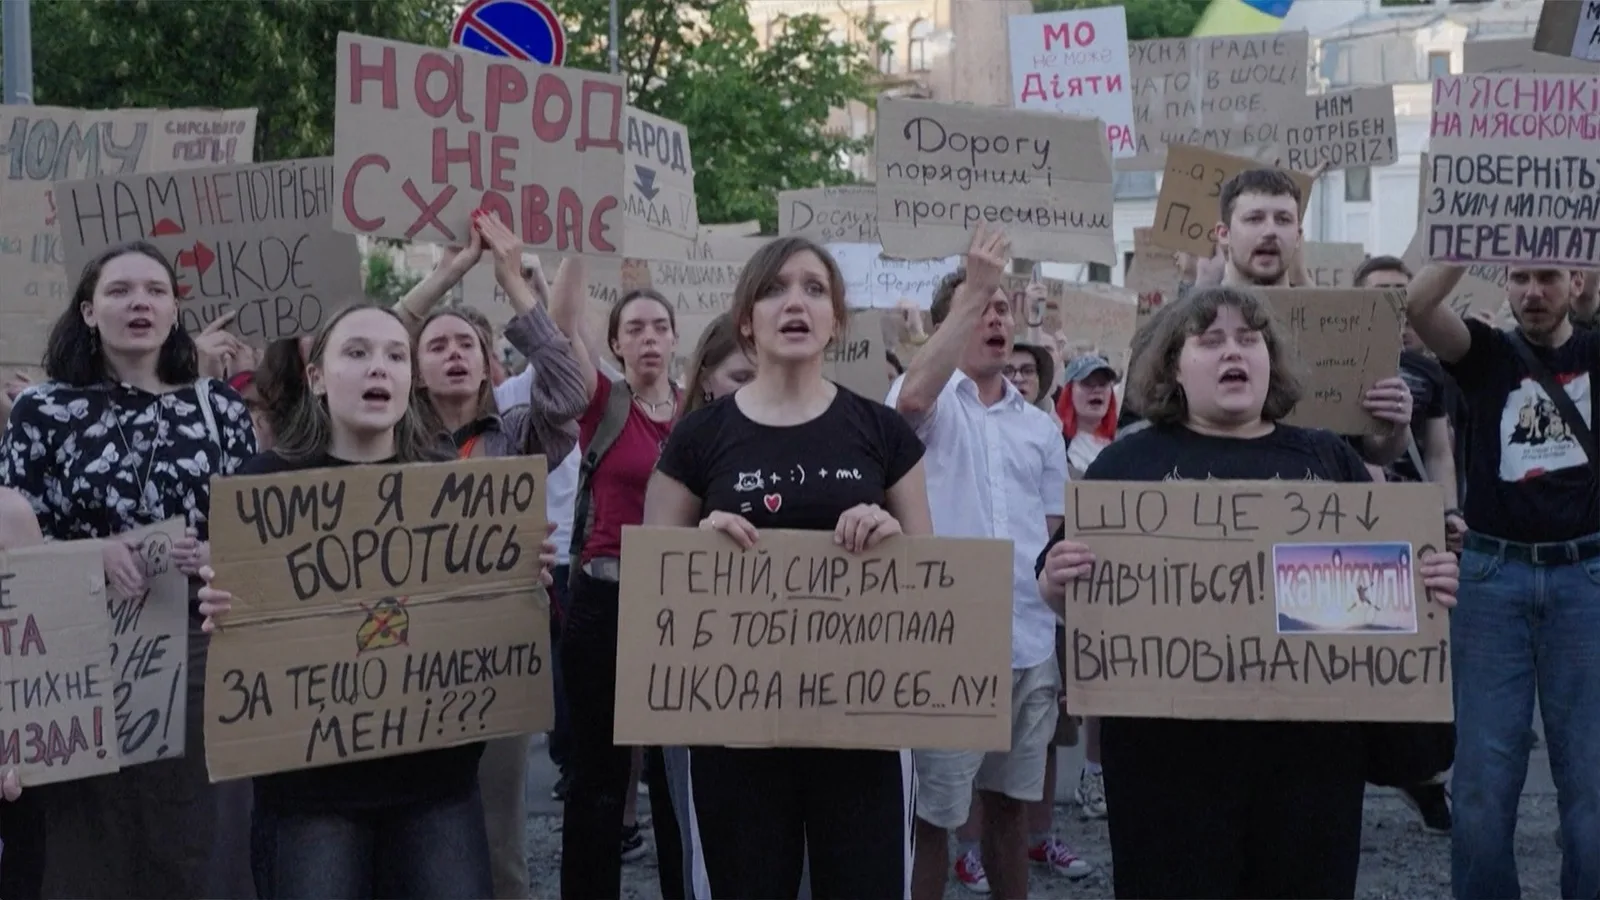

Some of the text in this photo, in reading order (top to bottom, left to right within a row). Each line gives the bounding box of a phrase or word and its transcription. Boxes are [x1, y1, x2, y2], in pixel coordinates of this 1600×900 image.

[1043, 20, 1096, 50] МО
[1286, 118, 1385, 145] ПОТРІБЕН
[1314, 94, 1353, 119] НАМ
[1430, 112, 1462, 138] НА
[431, 127, 520, 192] НЕ
[903, 116, 1050, 170] Дорогу
[886, 161, 1030, 191] порядним
[71, 176, 186, 246] НАМ
[894, 198, 1110, 230] прогресивним
[236, 471, 536, 544] ЧОМУ Я МАЮ
[1075, 489, 1347, 536] ШО ЦЕ ЗА
[286, 523, 522, 601] БОРОТИСЬ
[657, 547, 779, 600] ГЕНІЙ,
[1072, 550, 1267, 606] НАВЧІТЬСЯ!
[656, 608, 956, 650] Я Б ТОБІ ПОХЛОПАЛА
[1072, 628, 1448, 687] ВІДПОВІДАЛЬНОСТІ
[0, 663, 102, 713] ТИХНЕ
[218, 668, 273, 725] ЗА
[402, 641, 543, 695] НАЛЕЖИТЬ
[647, 663, 783, 712] ШКОДА
[799, 672, 837, 706] НЕ
[845, 669, 886, 703] ПО
